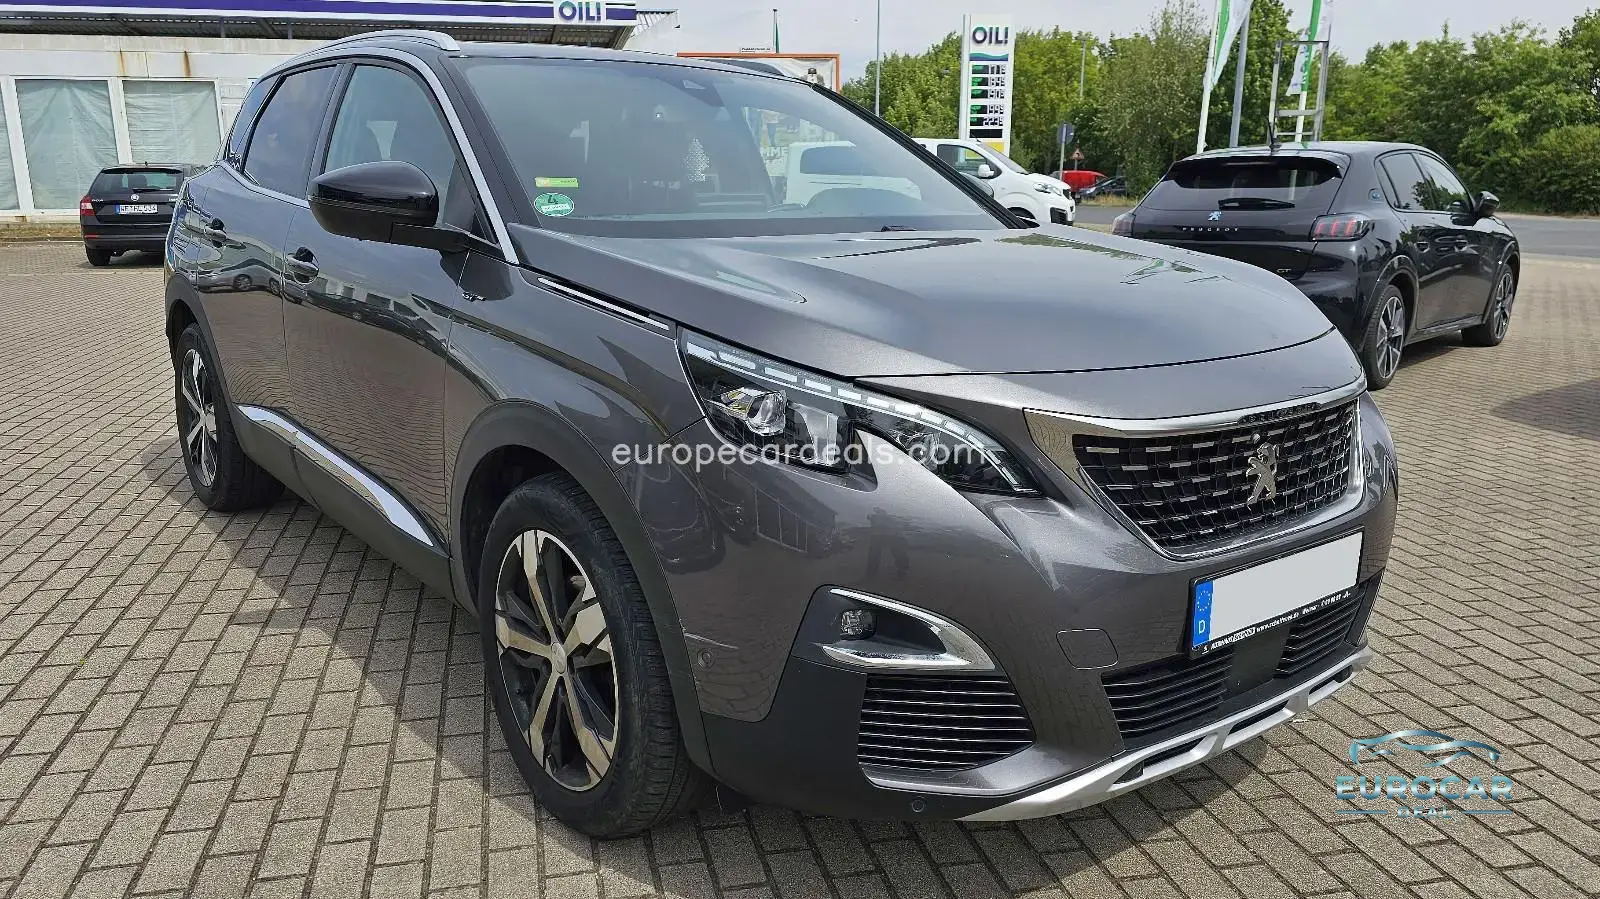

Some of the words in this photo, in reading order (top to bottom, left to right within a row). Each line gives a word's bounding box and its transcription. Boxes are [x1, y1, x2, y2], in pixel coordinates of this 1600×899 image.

[559, 1, 601, 21] OIL!
[972, 26, 1008, 45] OIL!
[1198, 619, 1206, 635] D
